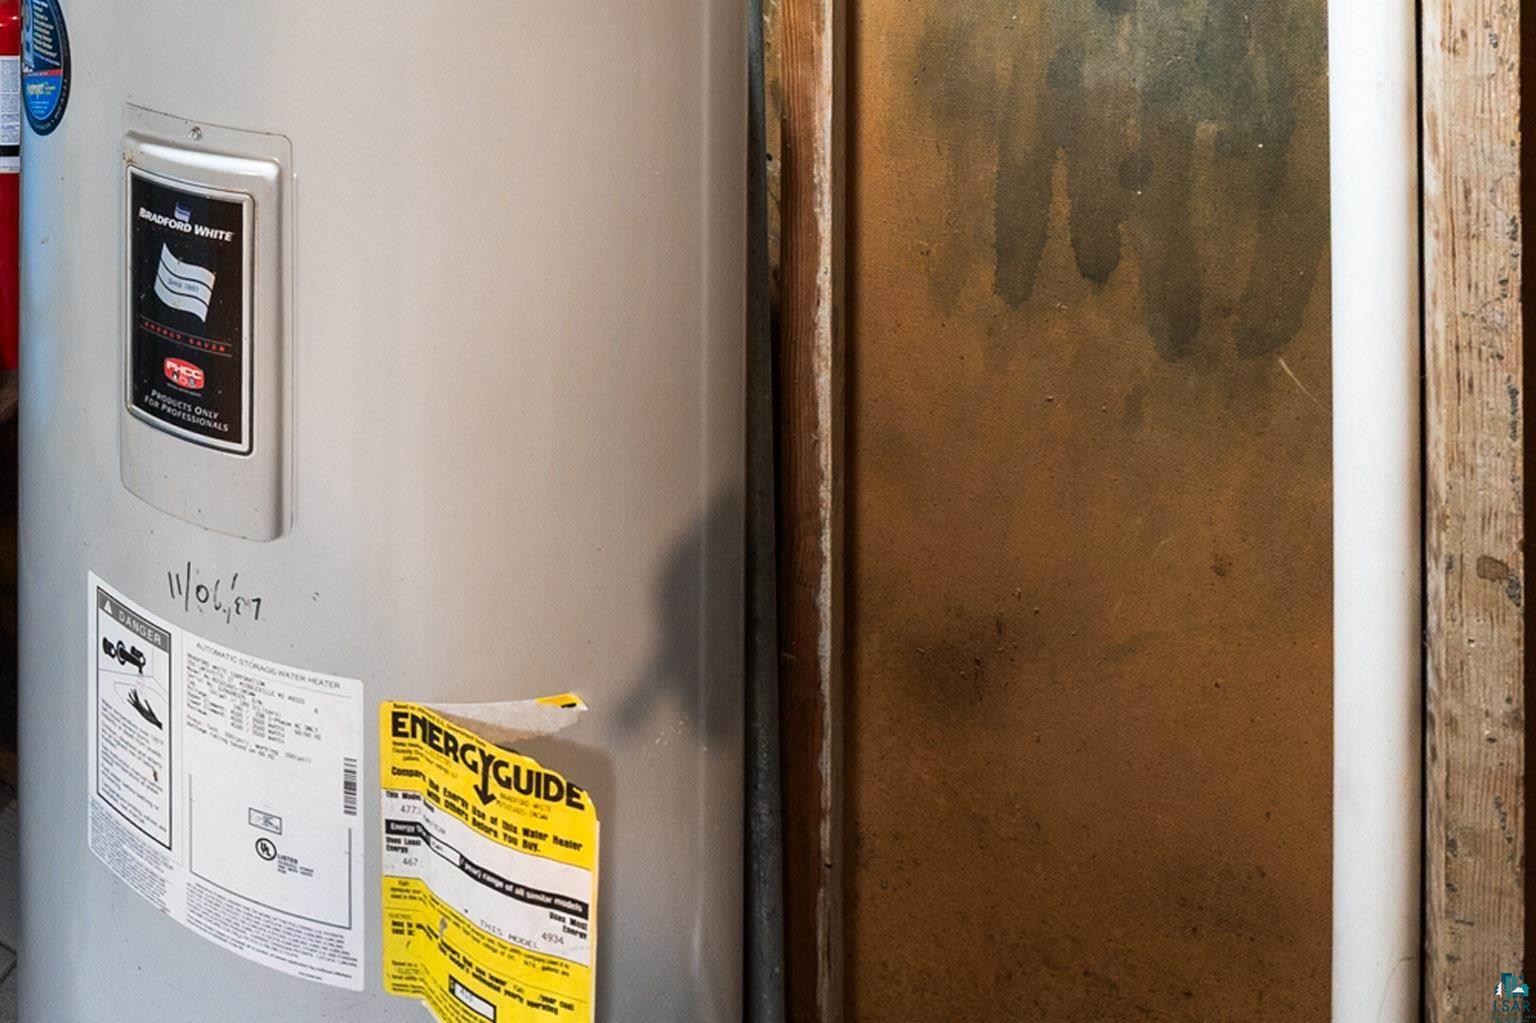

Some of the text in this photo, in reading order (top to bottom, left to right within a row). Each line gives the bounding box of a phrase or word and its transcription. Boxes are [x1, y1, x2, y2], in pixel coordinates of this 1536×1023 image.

[139, 207, 233, 242] BRADFORD WHITE
[166, 361, 204, 380] PHCC
[144, 394, 230, 432] FOR PROFESSIONALS
[151, 389, 192, 412] PRODUCTS
[194, 406, 220, 420] ONLY
[118, 610, 162, 646] DANGER
[196, 641, 238, 664] AUTOMATIC
[278, 670, 307, 682] WATER
[308, 676, 341, 689] HEATER
[391, 711, 585, 811] ENERGYGUIDE
[390, 822, 415, 833] Energy
[443, 787, 469, 811] Energy
[472, 805, 486, 821] Use
[490, 816, 498, 825] of
[502, 820, 518, 834] this
[522, 827, 548, 841] Water
[552, 835, 583, 851] Heater
[472, 817, 498, 838] Before
[503, 832, 518, 846] You
[386, 845, 409, 854] Energy
[505, 883, 514, 892] of
[515, 887, 525, 896] all
[526, 890, 552, 904] similar
[553, 897, 583, 912] models
[479, 919, 539, 950] THIS MODEL
